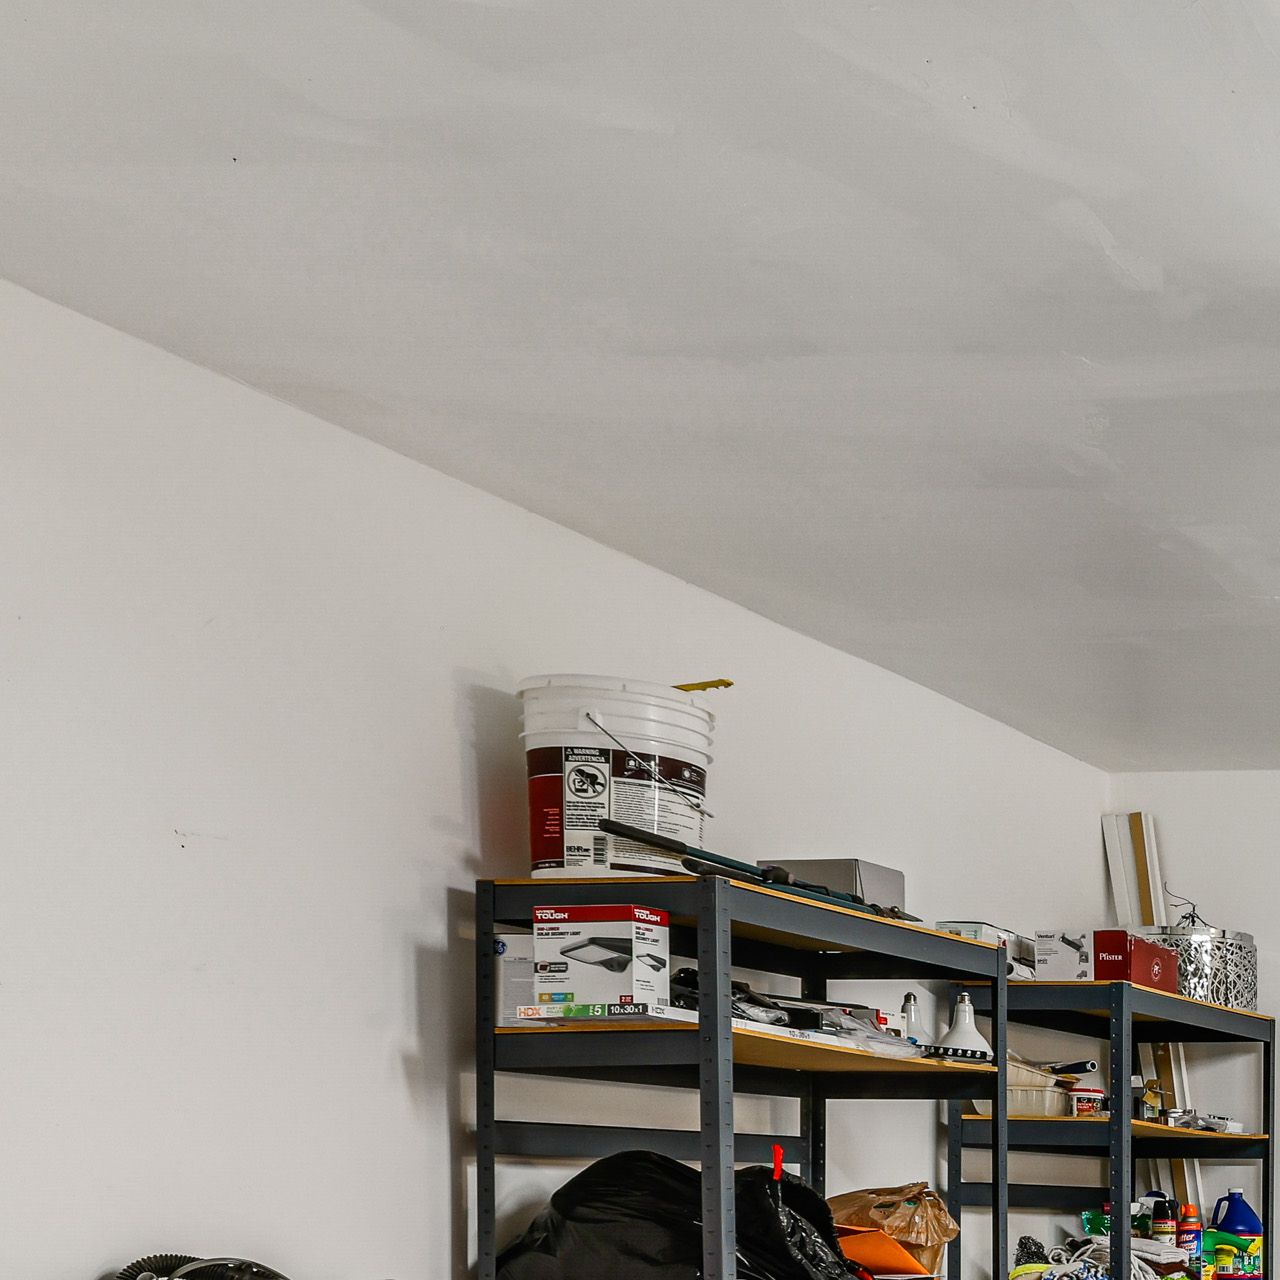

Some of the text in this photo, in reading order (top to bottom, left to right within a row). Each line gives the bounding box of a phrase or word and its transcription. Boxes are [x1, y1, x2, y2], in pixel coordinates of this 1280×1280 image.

[536, 912, 569, 920] TOUGH
[634, 911, 661, 922] TOUGH
[518, 1007, 543, 1018] HDX
[594, 1004, 602, 1016] 5
[610, 1005, 643, 1014] 10x30x1
